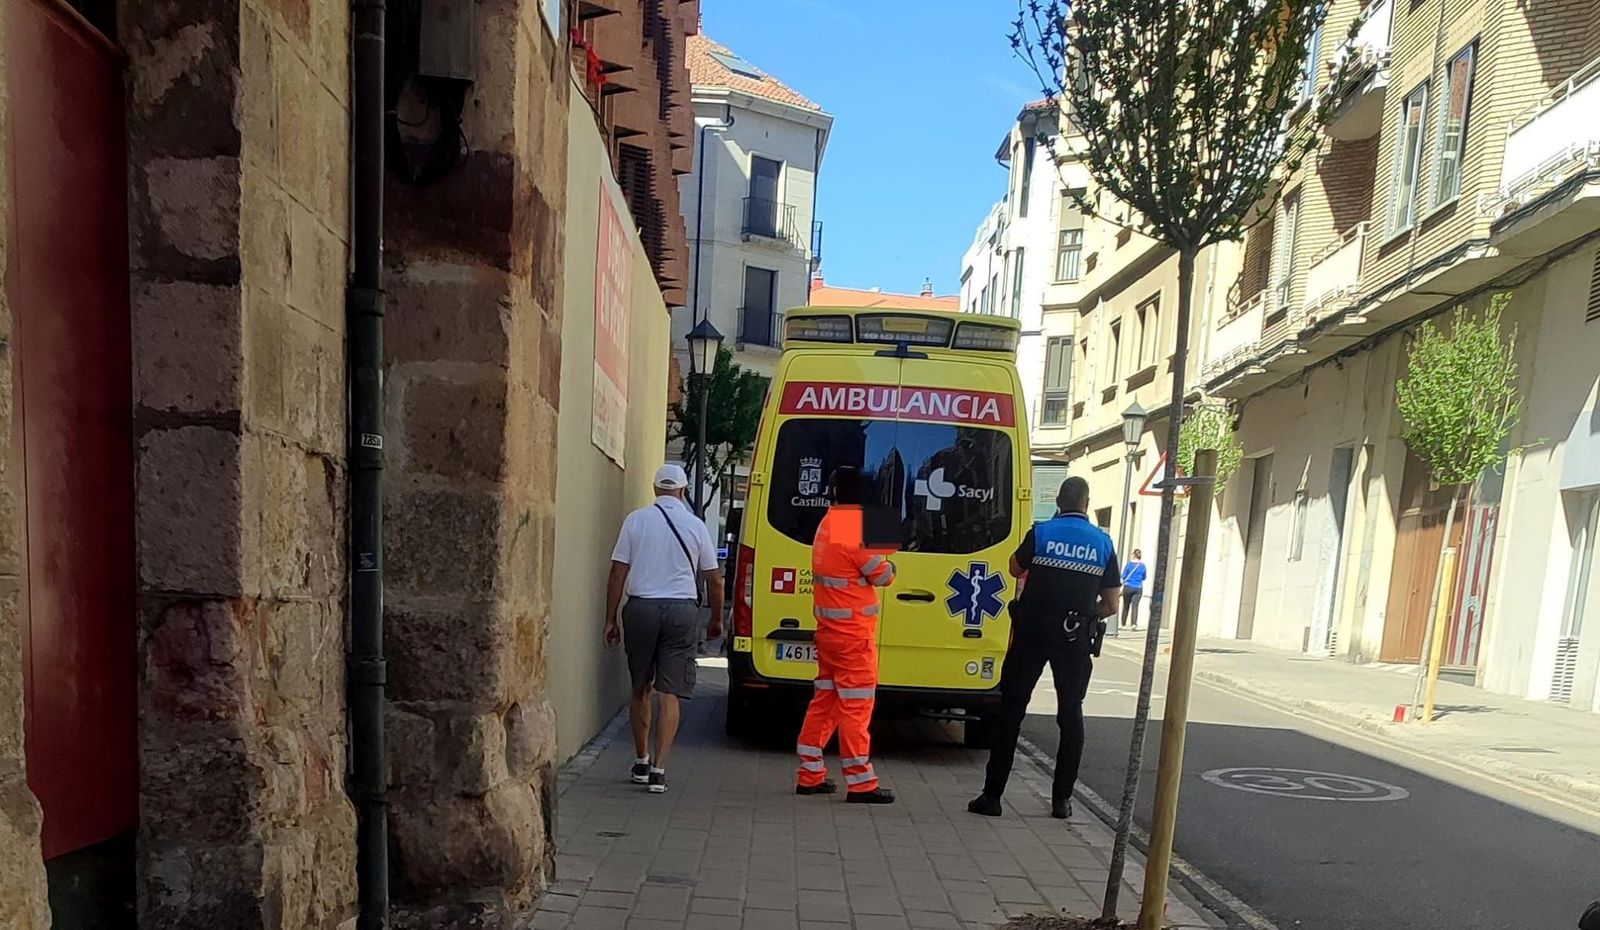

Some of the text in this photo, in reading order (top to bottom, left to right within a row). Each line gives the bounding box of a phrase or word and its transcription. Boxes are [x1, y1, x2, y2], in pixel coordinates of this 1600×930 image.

[796, 387, 1001, 421] AMBULANCIA
[791, 496, 831, 508] Castilla
[958, 484, 994, 501] Sacyl
[1046, 540, 1098, 562] POLICÍA
[1231, 774, 1376, 794] 30
